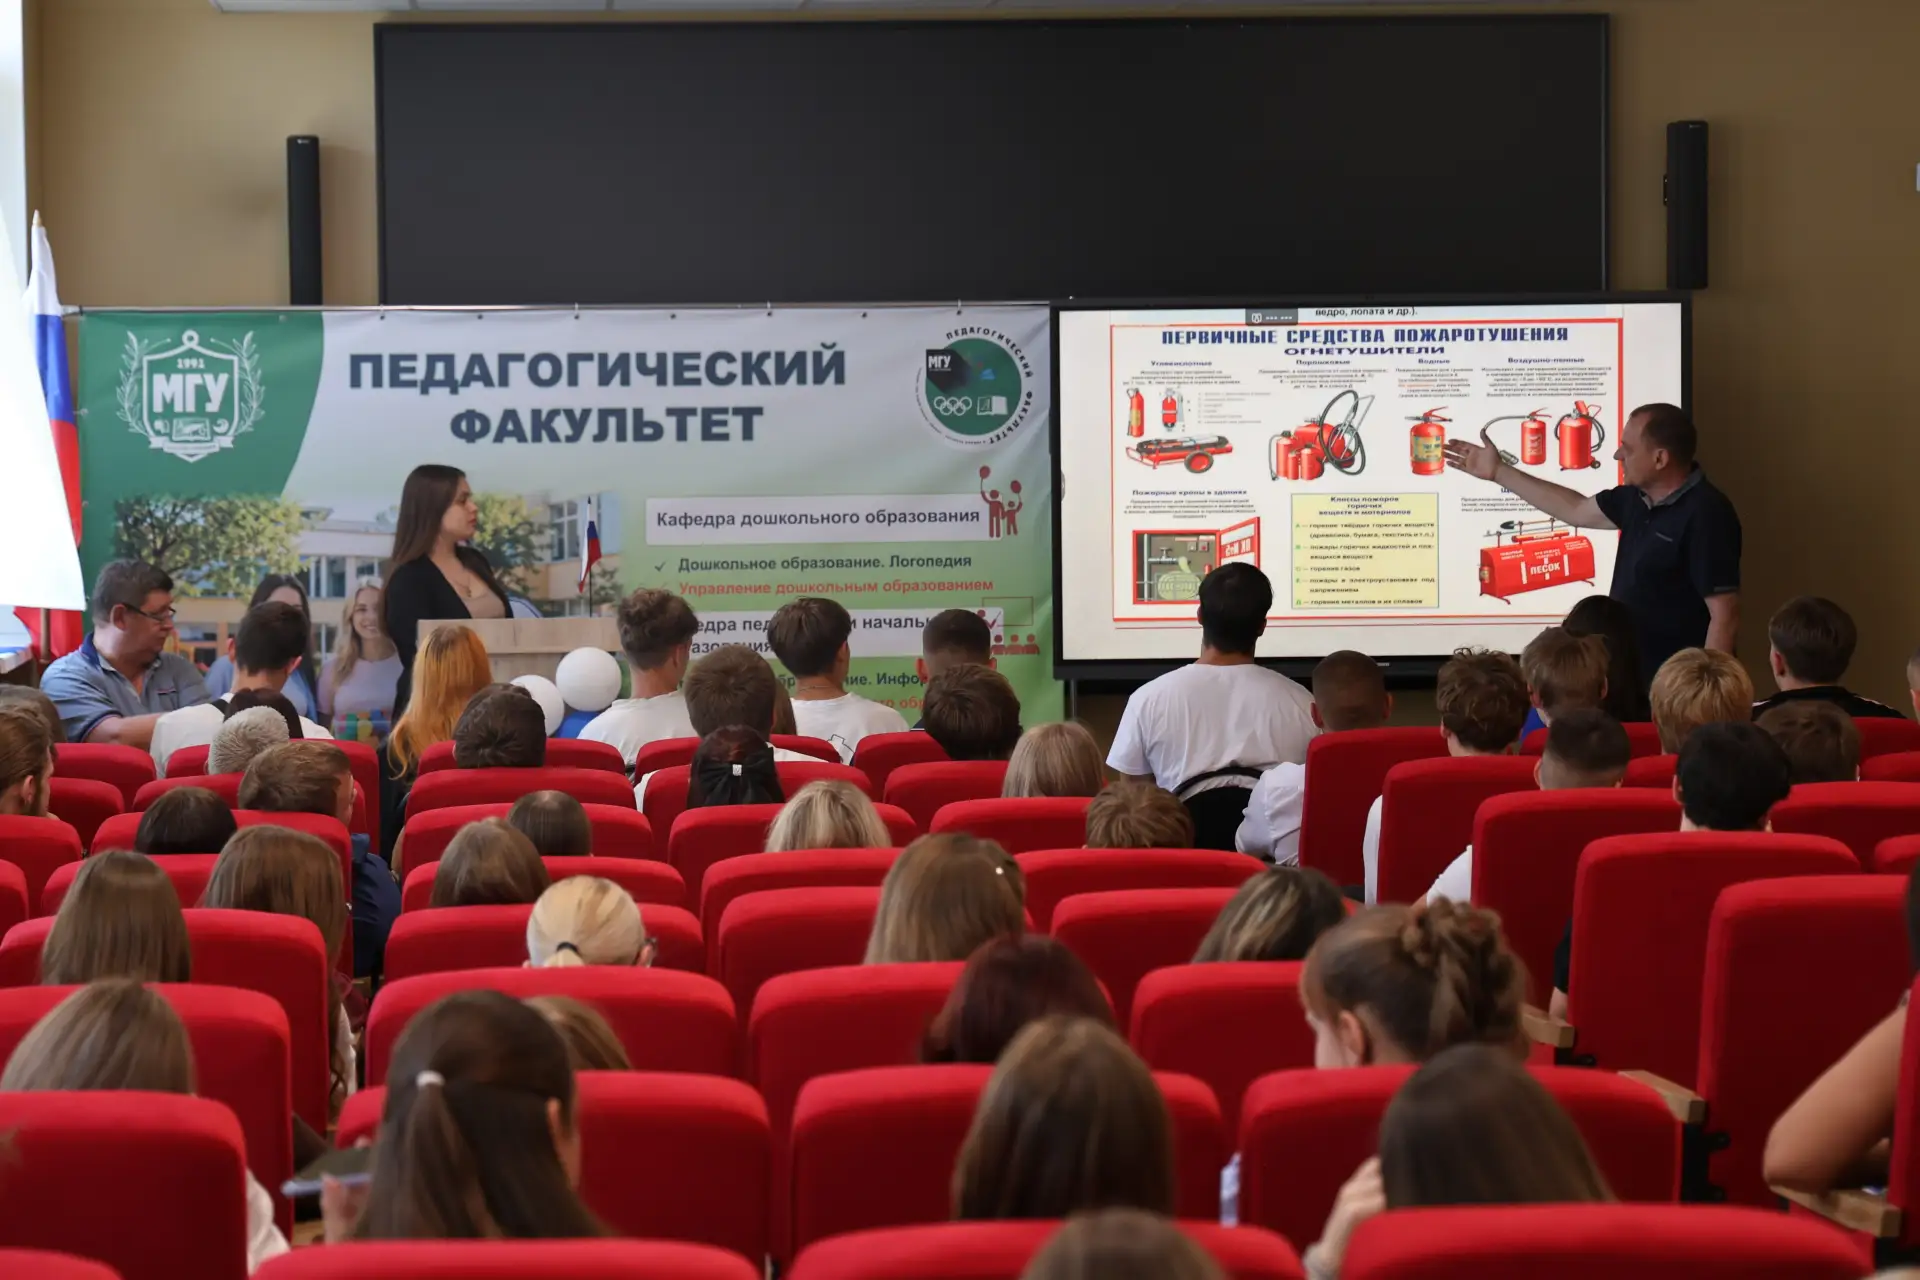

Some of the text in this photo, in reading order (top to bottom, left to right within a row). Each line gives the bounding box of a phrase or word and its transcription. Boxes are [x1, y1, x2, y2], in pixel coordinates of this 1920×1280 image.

[1315, 308, 1347, 317] ведро,
[1351, 308, 1385, 316] лопата
[1396, 306, 1418, 317] др.).
[1162, 327, 1569, 345] ПЕРВИЧНЫЕ СРЕДСТВА ПОЖАРОТУШЕНИЯ
[946, 326, 1034, 378] ПЕДАГОГИЧЕСКИЙ
[1284, 346, 1446, 356] ОГНЕТУШИТЕЛИ
[176, 358, 206, 370] 1991
[349, 342, 846, 396] ПЕДАГОГИЧЕСКИЙ
[928, 355, 952, 368] МГУ
[152, 372, 230, 413] МГУ
[450, 406, 764, 444] ФАКУЛЬТЕТ
[989, 391, 1033, 445] ФАКУЛЬТЕТ
[656, 507, 980, 530] Кафедра дошкольного образования
[678, 554, 972, 574] Дошкольное образование. Логопедия
[1530, 562, 1561, 576] ПЕСОК
[679, 578, 994, 598] Управление дошкольным образованием
[697, 620, 737, 634] едра
[862, 616, 929, 629] началь
